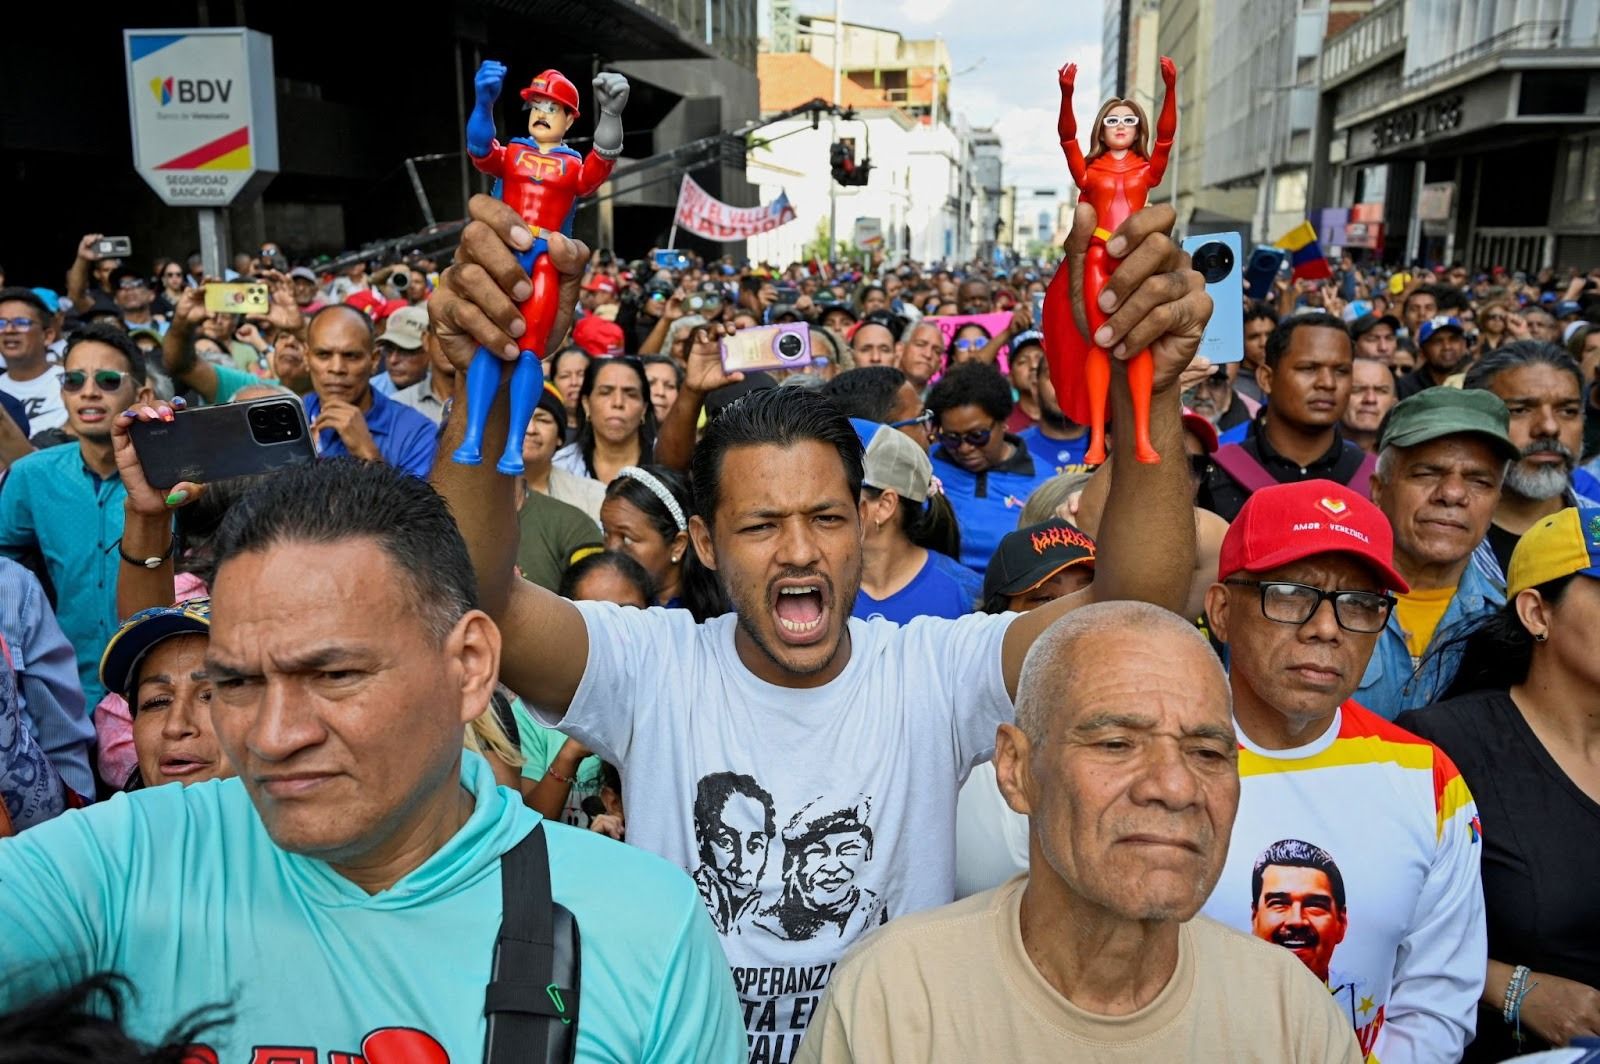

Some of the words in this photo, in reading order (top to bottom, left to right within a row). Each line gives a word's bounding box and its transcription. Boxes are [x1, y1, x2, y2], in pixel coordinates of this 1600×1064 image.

[177, 79, 232, 103] BDV
[166, 174, 228, 186] SEGURIDAD
[170, 187, 225, 198] BANCARIA
[680, 205, 797, 237] MADURO
[1293, 522, 1320, 531] AMOR
[1329, 523, 1369, 544] VENEZUELA
